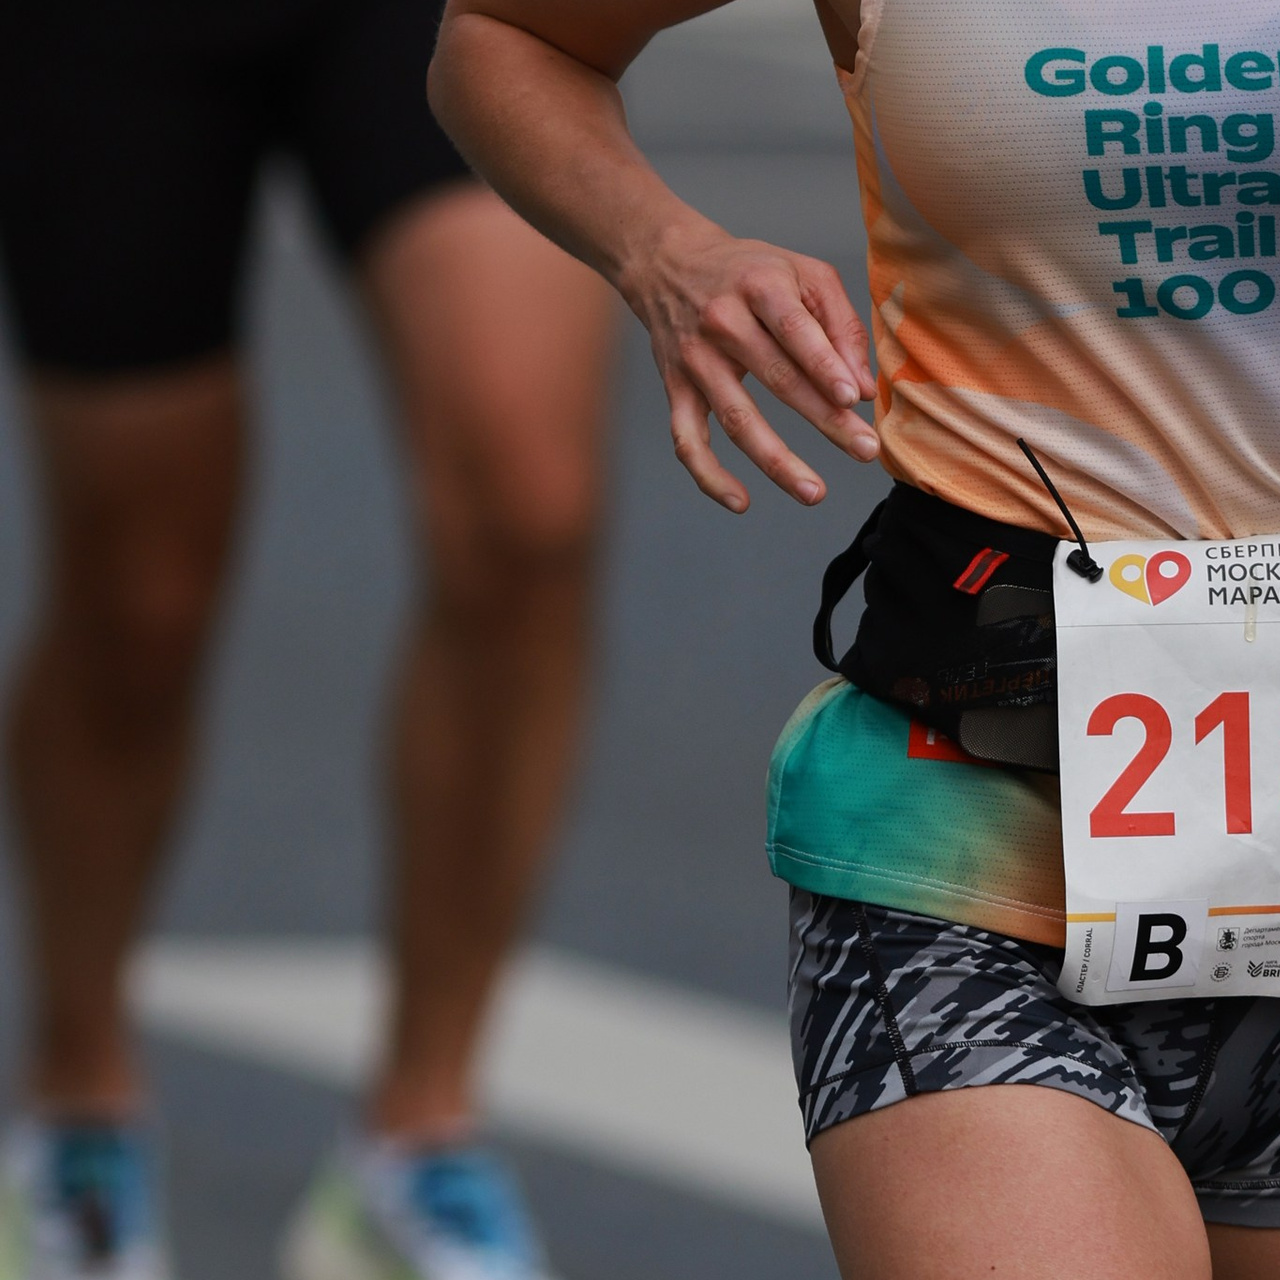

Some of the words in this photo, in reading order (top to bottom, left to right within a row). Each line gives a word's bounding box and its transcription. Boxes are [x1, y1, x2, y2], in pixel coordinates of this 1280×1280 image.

[1084, 101, 1276, 164] Ring
[1098, 211, 1277, 265] Trail
[1111, 269, 1276, 321] 100
[1075, 963, 1089, 994] КЛАСТЕР
[1083, 927, 1093, 958] CORRAL
[1241, 941, 1264, 949] города
[1242, 934, 1266, 942] спорта
